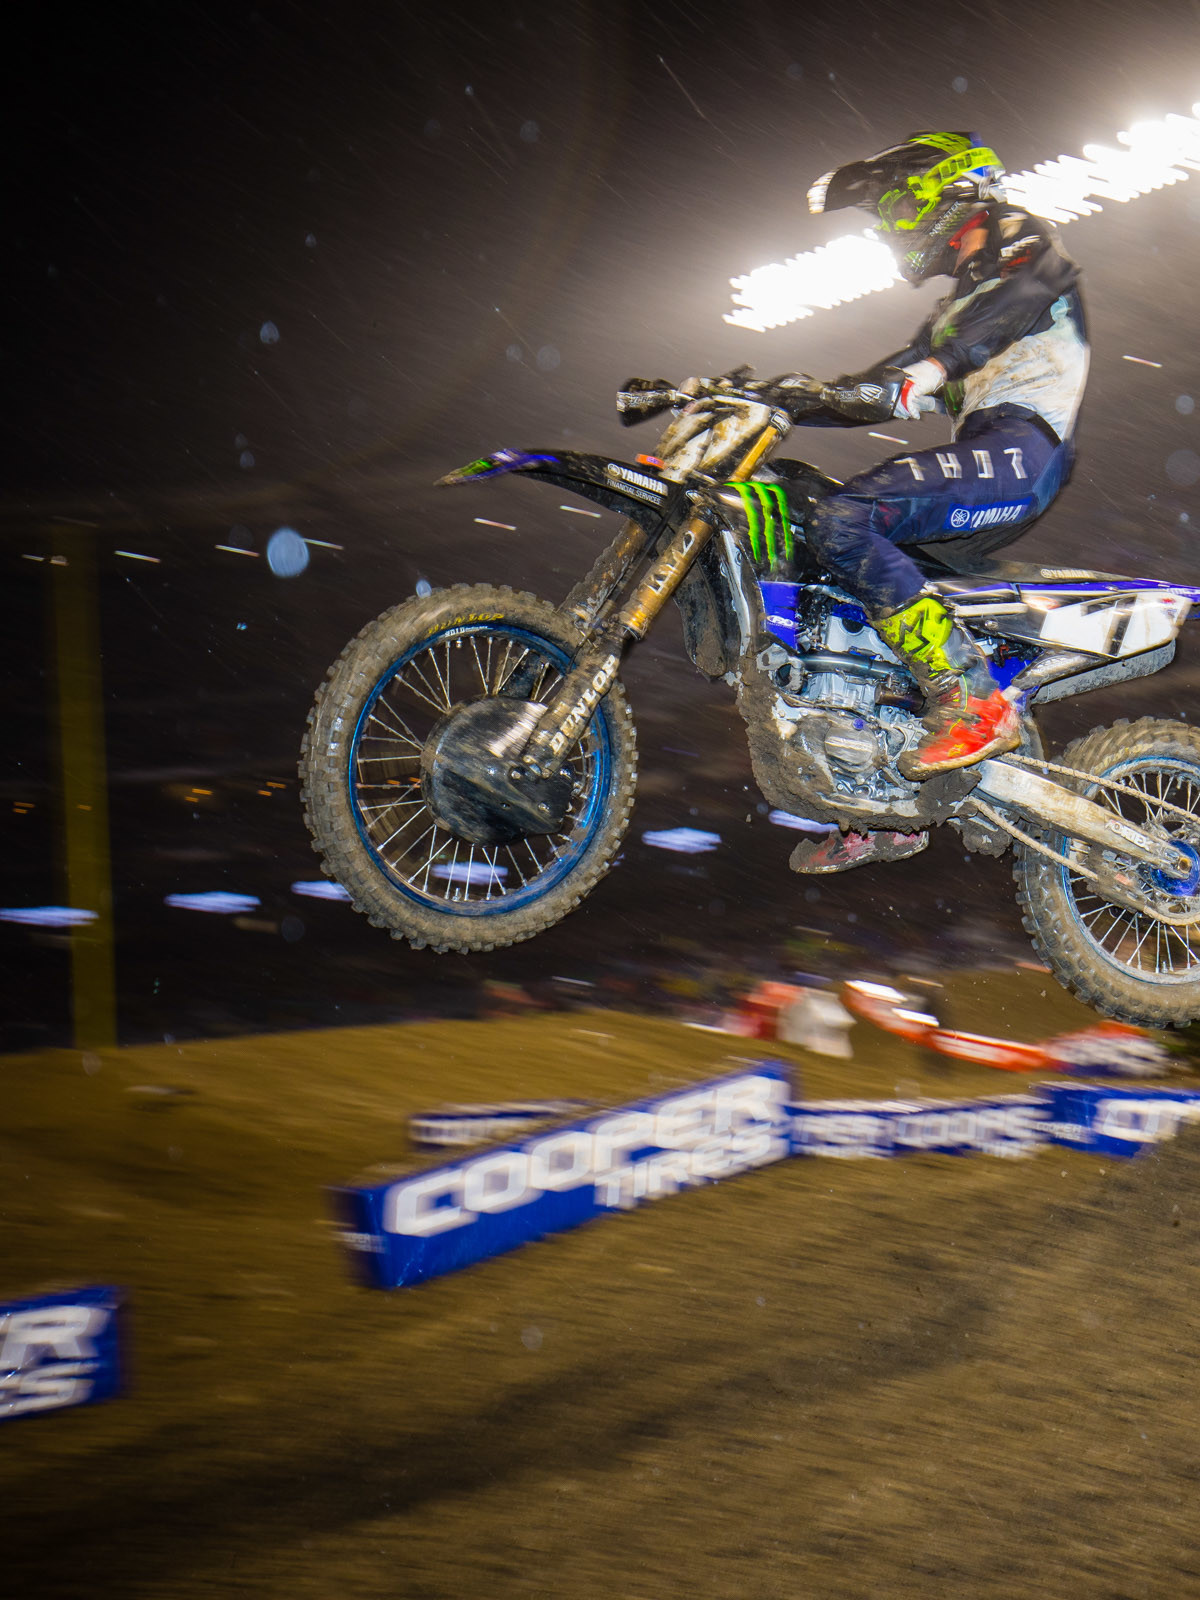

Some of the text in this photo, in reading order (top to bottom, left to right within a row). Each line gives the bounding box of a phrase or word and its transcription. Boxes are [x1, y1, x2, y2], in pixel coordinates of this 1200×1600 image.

[929, 200, 961, 238] MONSTER
[607, 478, 661, 505] FINANCIAL SERVICES
[619, 466, 666, 496] YAMAHA
[1050, 568, 1096, 579] YAMAHA
[549, 654, 618, 757] DUNLOP
[385, 1076, 788, 1236] COOPER
[596, 1122, 785, 1209] TIRES
